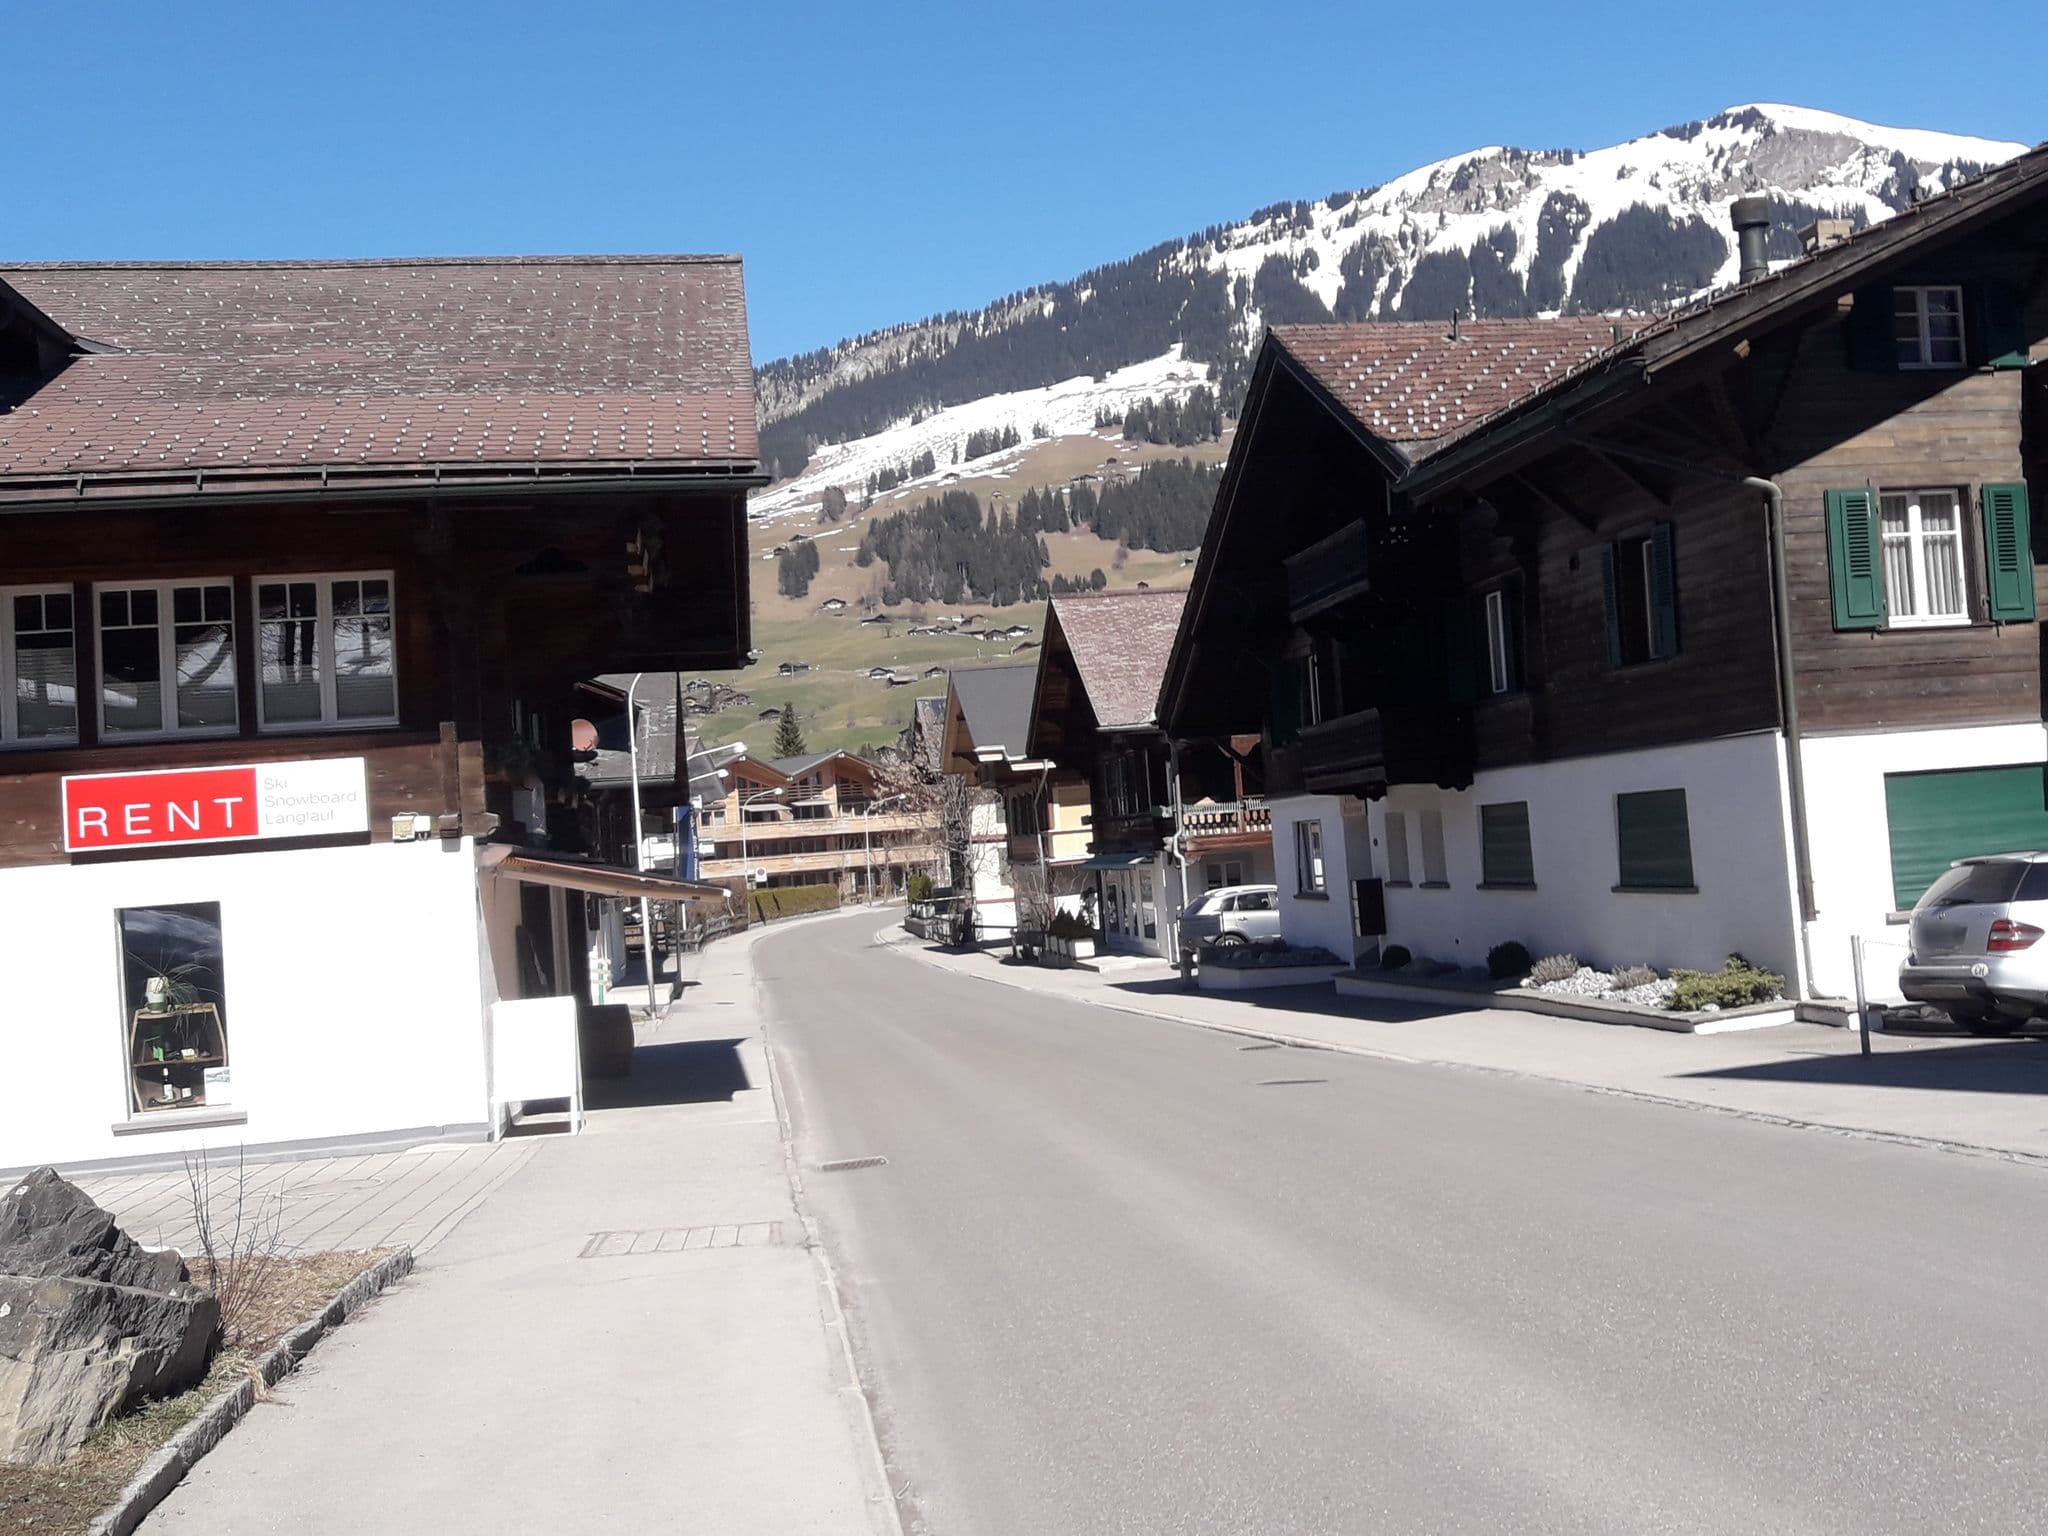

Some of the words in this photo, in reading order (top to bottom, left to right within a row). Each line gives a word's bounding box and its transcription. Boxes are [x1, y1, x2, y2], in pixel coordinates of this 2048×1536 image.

[263, 777, 288, 791] Ski
[264, 791, 358, 808] Snowboard
[77, 797, 243, 839] RENT
